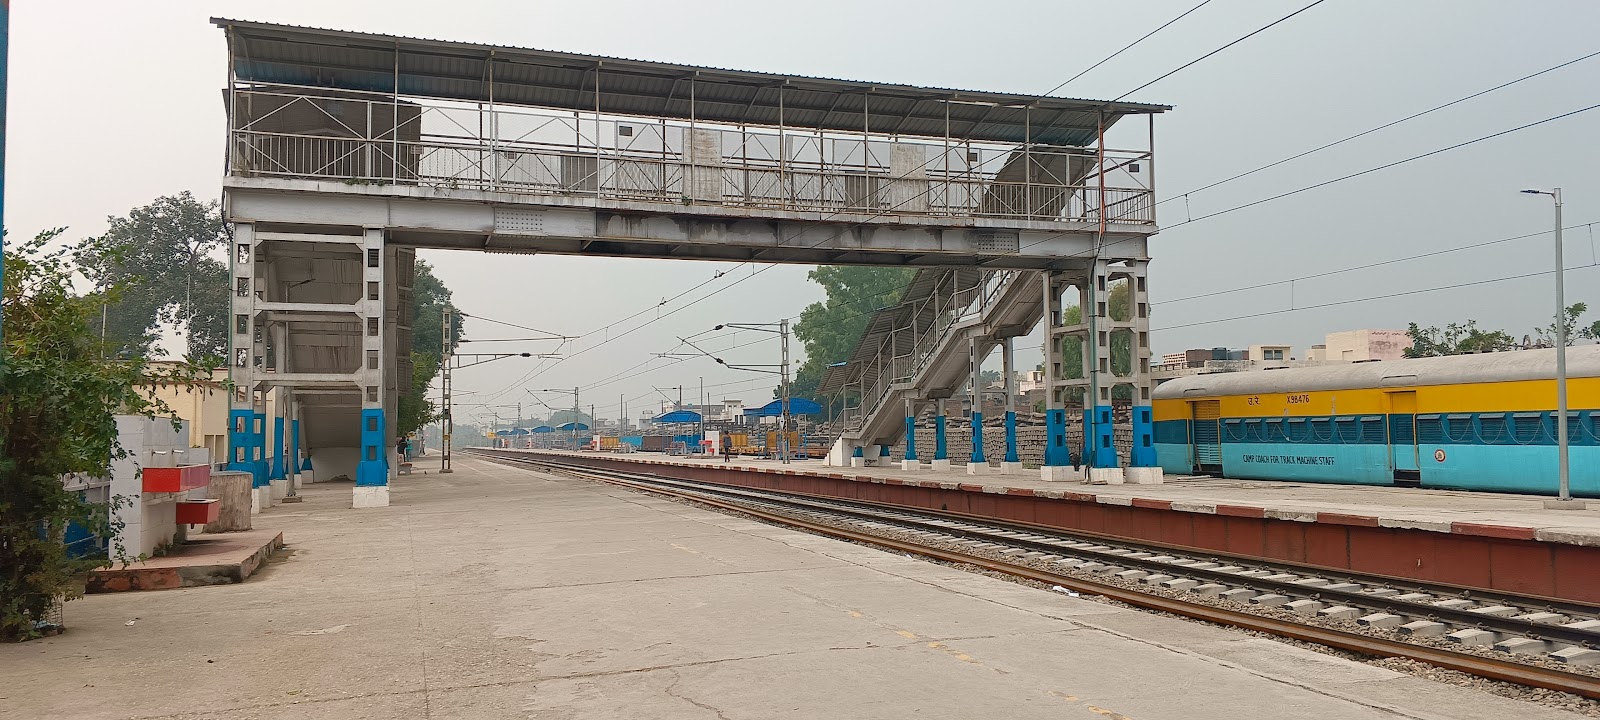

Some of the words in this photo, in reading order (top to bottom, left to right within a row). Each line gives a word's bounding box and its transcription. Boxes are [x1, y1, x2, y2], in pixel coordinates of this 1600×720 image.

[1242, 454, 1255, 463] CAMP
[1255, 455, 1269, 464] COACH
[1270, 455, 1280, 464] FOR
[1280, 455, 1296, 464] TRACK
[1296, 456, 1318, 465] MACHINE
[1318, 456, 1335, 466] STAFF
